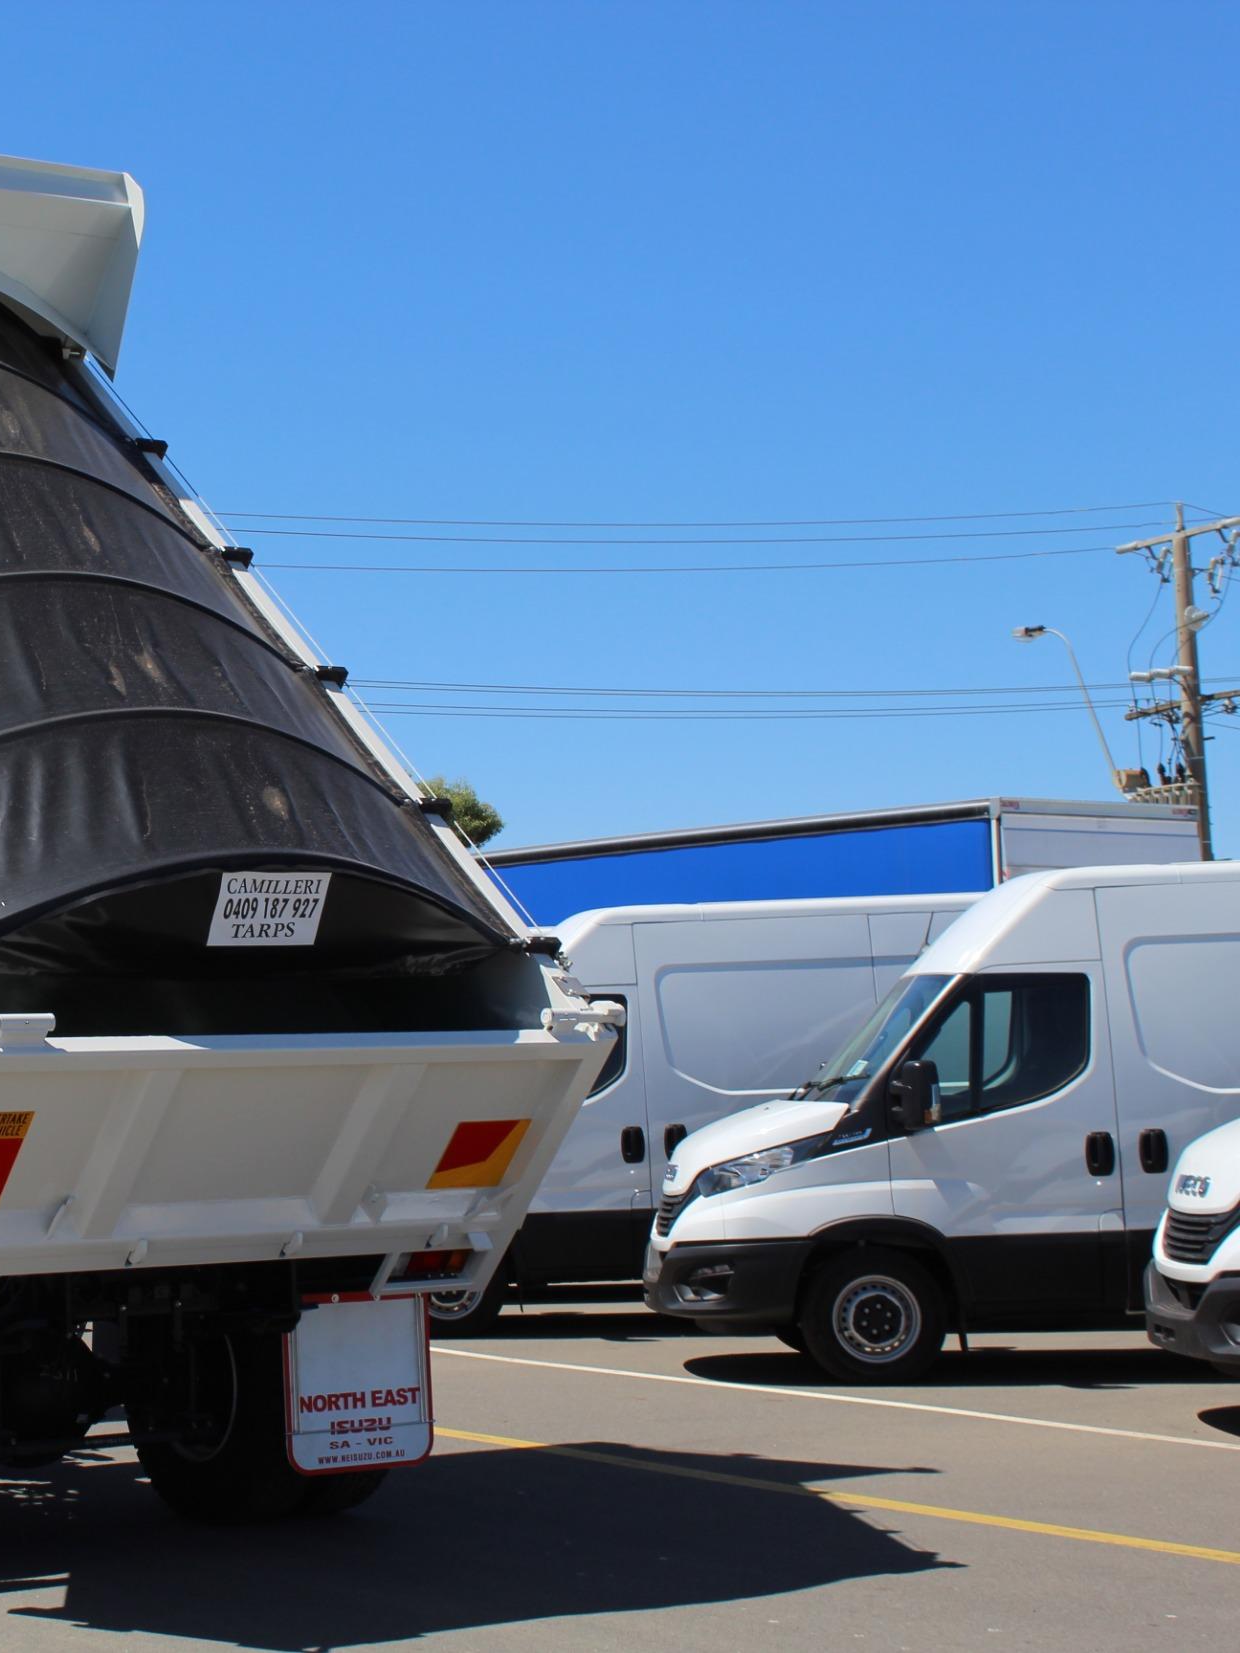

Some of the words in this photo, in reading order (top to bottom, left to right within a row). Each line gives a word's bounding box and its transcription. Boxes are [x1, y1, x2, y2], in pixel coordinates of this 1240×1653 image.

[227, 878, 322, 895] CAMILLERI
[223, 897, 259, 919] 0409
[263, 897, 290, 919] 187
[292, 897, 320, 919] 927
[231, 921, 296, 939] TARPS
[299, 1391, 366, 1414] NORTH
[371, 1386, 420, 1407] EAST
[330, 1417, 392, 1435] ISUZU
[329, 1441, 351, 1450] SA
[367, 1436, 394, 1446] VIC
[317, 1449, 406, 1465] WWW.NEISUZU.COM.AU
